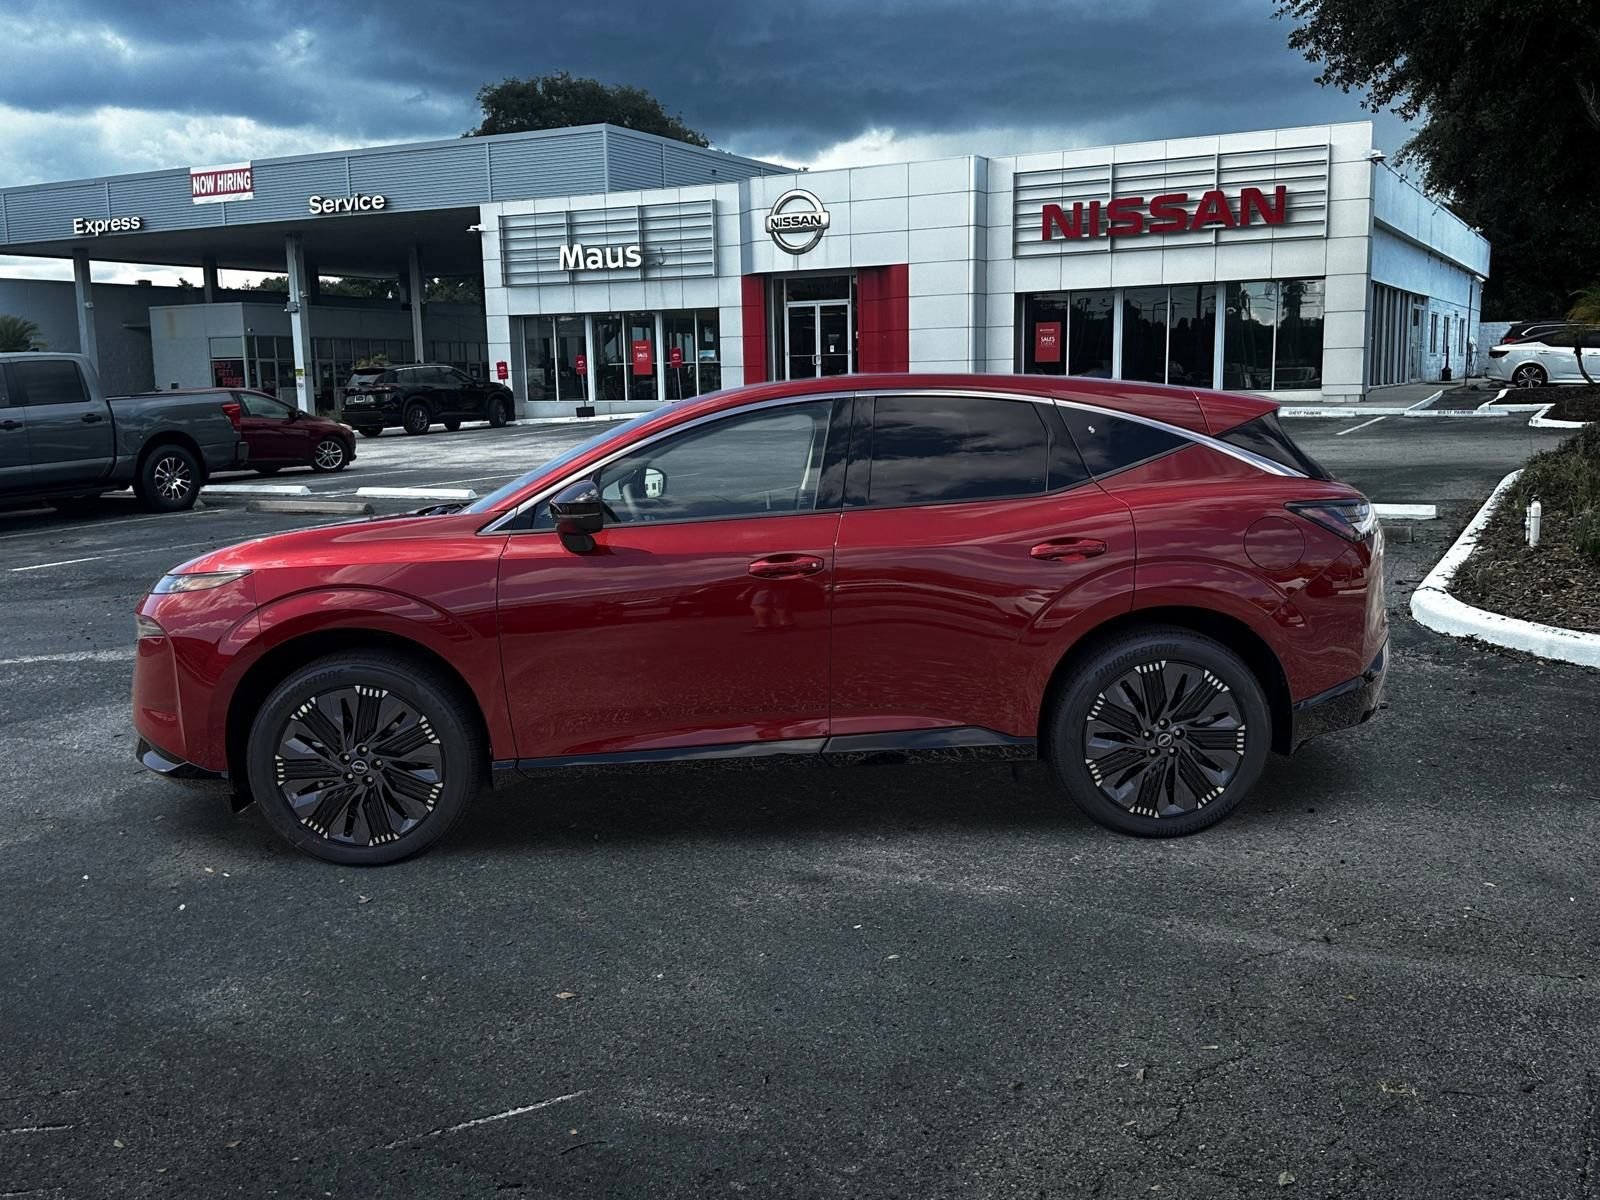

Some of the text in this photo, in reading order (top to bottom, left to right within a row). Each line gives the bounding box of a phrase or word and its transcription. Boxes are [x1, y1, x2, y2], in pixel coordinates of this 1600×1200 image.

[193, 170, 251, 195] NOW HIRING
[309, 192, 385, 214] Service
[1041, 185, 1287, 240] NISSAN
[73, 216, 140, 237] Express
[770, 214, 822, 228] NISSAN
[560, 243, 642, 271] Maus
